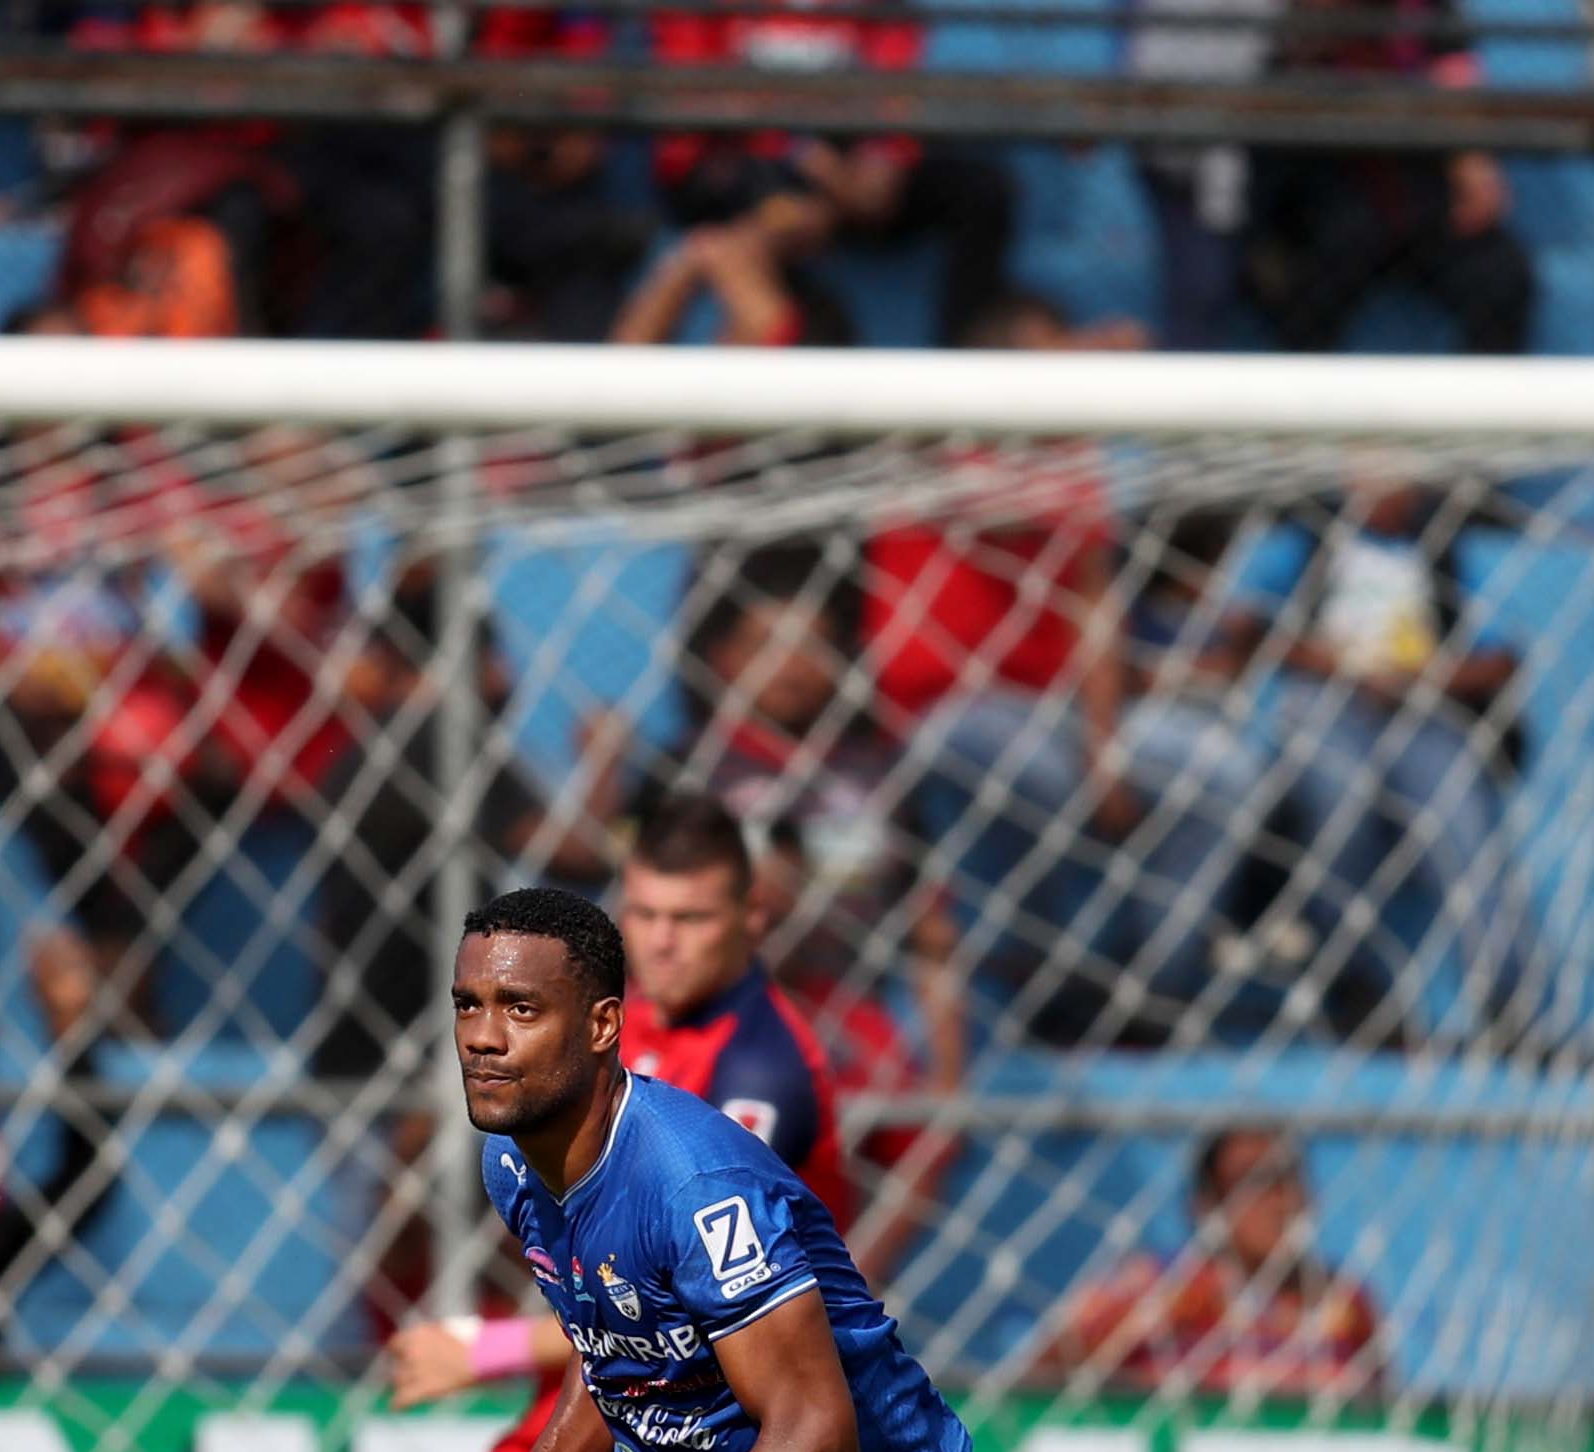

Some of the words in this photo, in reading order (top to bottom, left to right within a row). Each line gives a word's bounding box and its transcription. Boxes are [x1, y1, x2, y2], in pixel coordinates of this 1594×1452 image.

[702, 1203, 758, 1273] Z
[728, 1268, 766, 1293] GAS
[567, 1322, 703, 1362] BANTRAB
